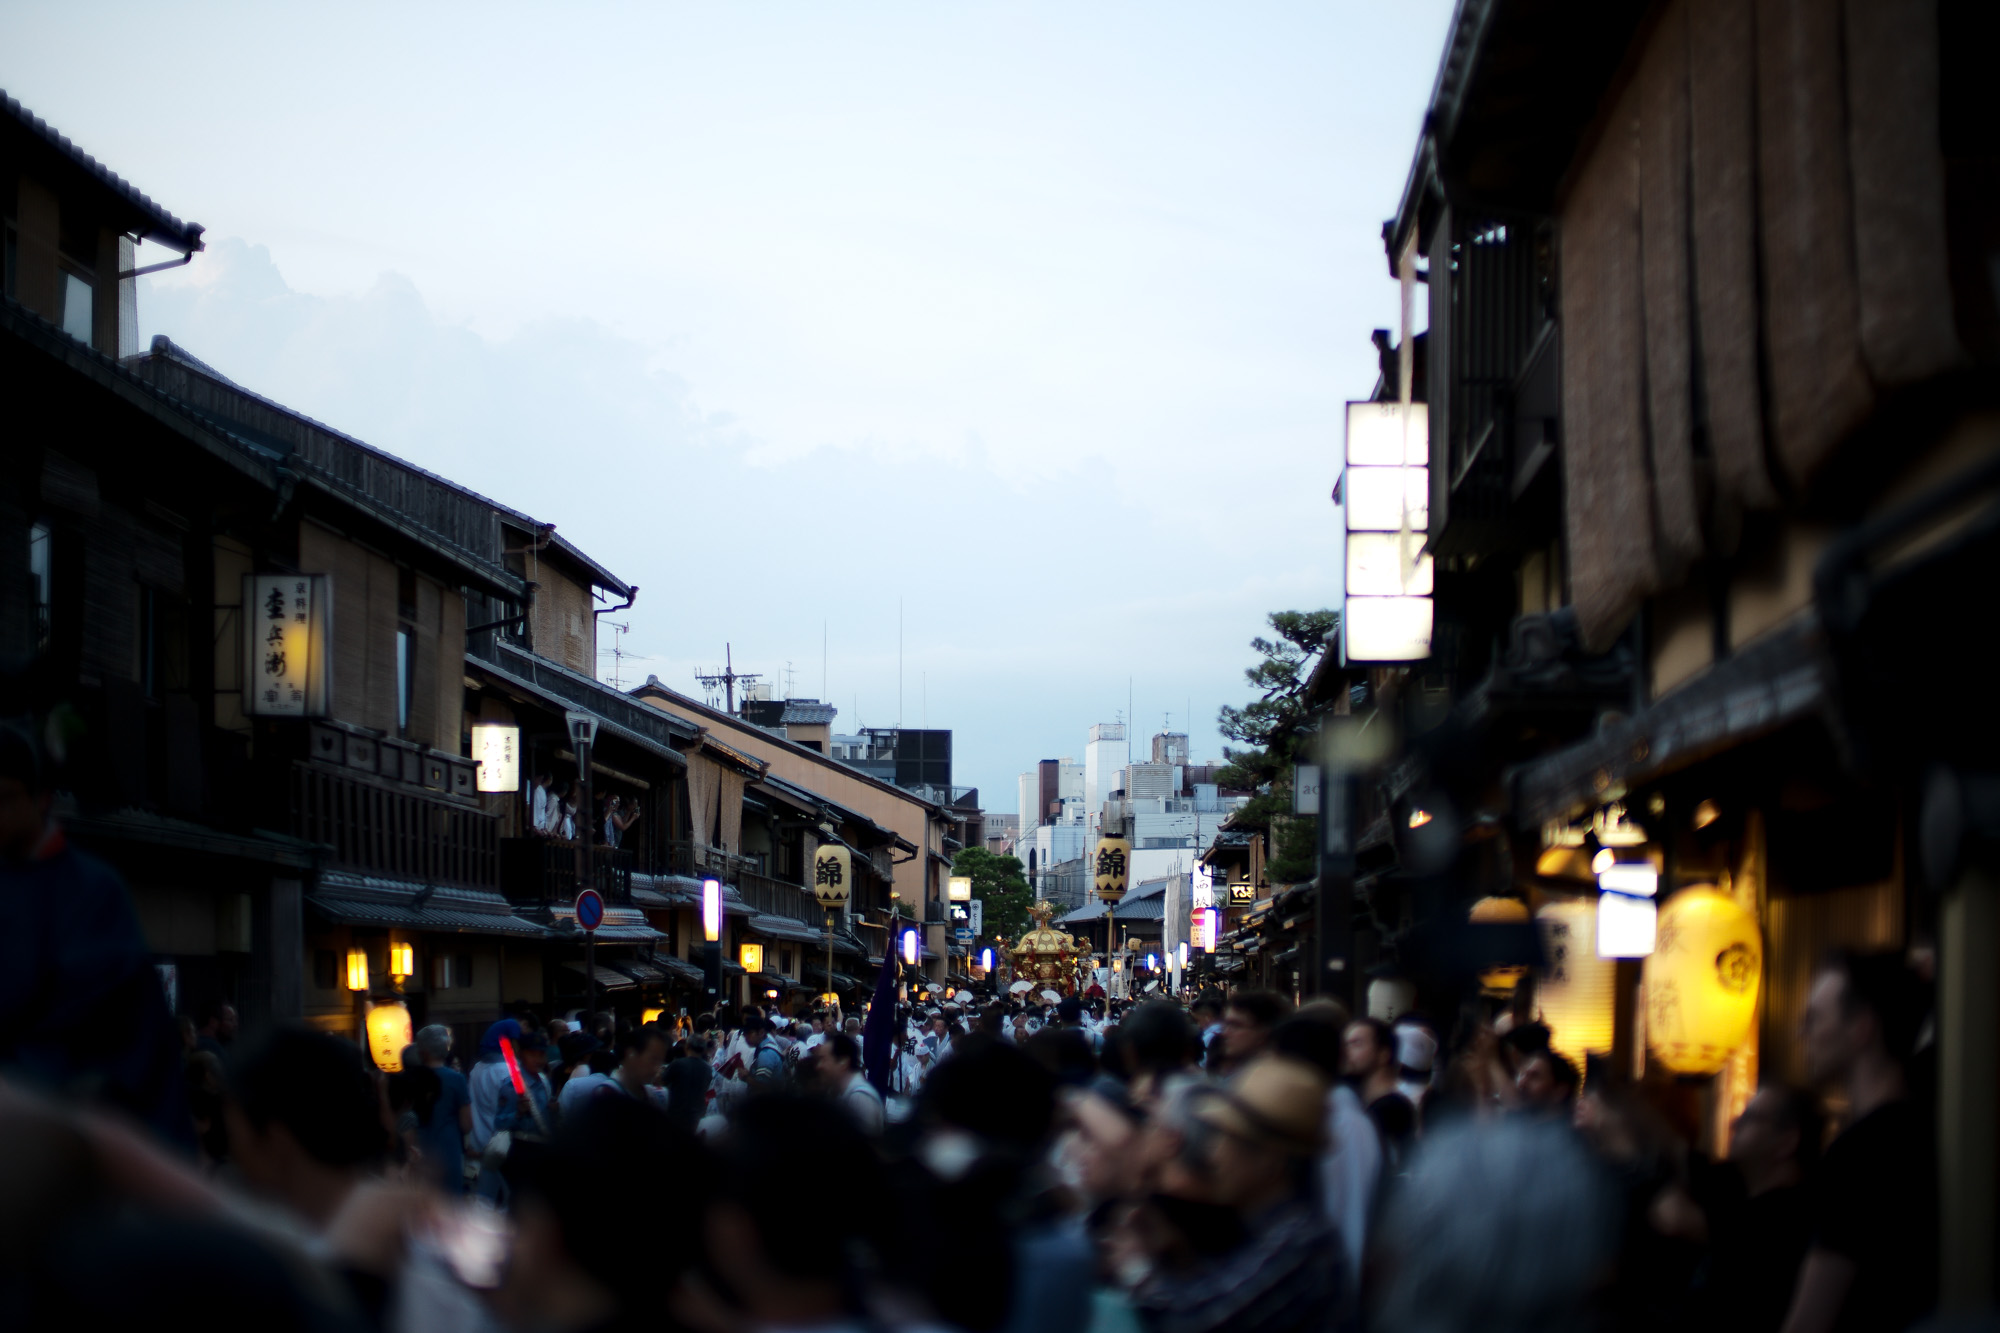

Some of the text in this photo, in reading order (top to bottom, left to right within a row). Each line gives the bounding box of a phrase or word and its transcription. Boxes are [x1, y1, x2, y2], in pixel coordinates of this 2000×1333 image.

[295, 582, 306, 624] 京料理
[816, 856, 842, 888] 錦
[1096, 847, 1125, 879] 錦
